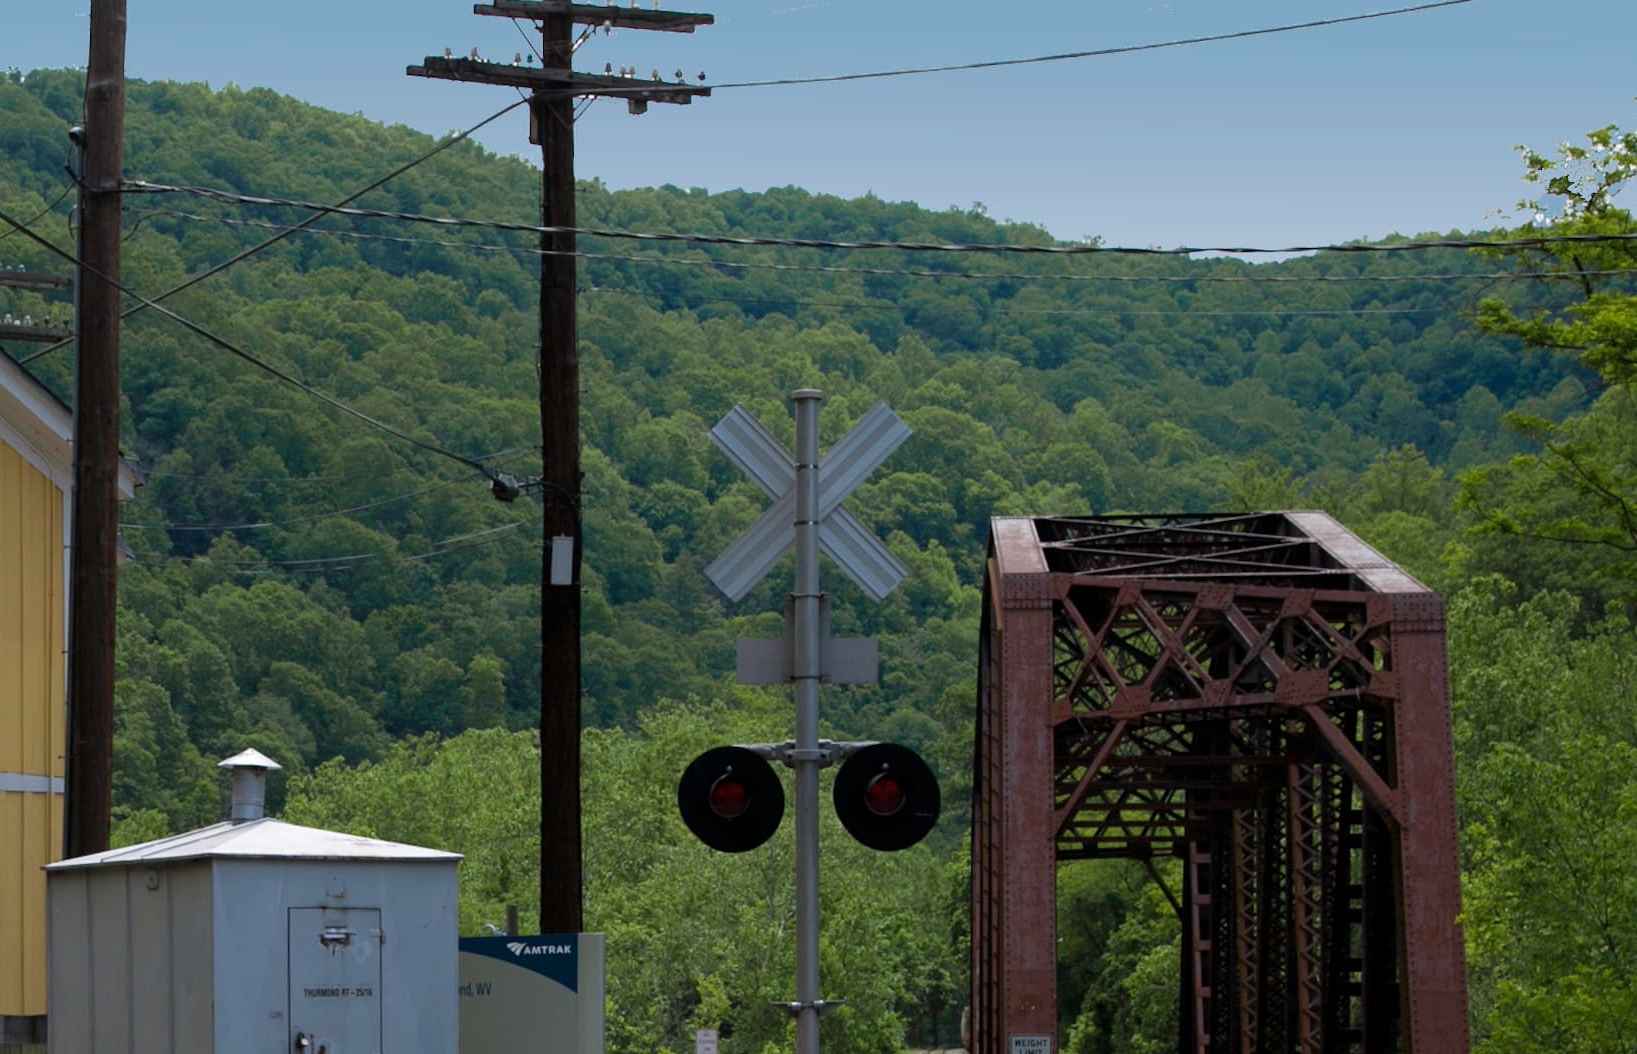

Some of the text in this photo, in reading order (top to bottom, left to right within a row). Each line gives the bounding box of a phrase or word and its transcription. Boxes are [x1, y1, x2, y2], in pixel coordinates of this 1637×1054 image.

[523, 944, 571, 955] AMTRAK
[476, 983, 491, 996] WV
[1014, 1039, 1047, 1048] WEIGHT
